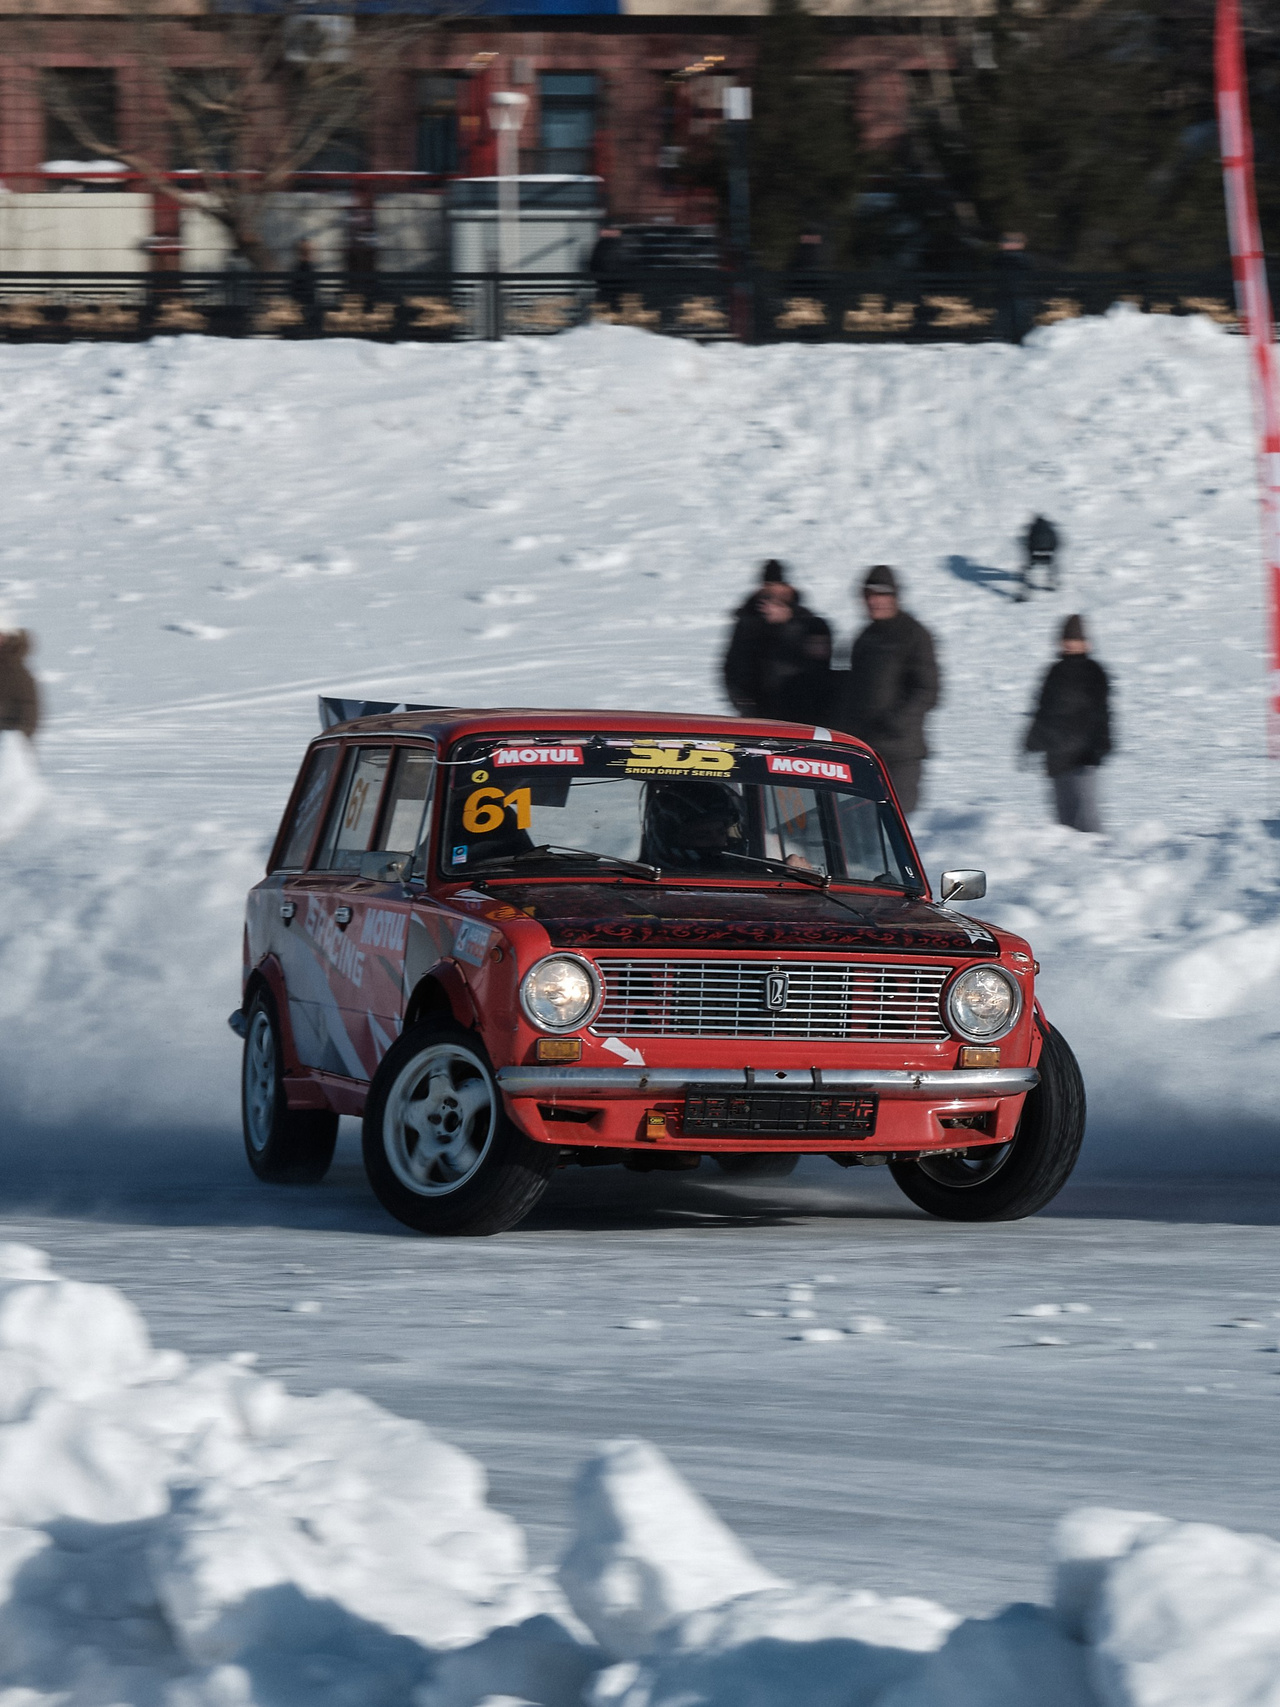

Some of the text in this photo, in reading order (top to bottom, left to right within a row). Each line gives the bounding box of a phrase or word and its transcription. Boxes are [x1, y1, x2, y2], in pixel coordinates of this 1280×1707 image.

[497, 747, 580, 766] MOTUL
[624, 767, 732, 778] SNOW DRIFT SERIES
[770, 758, 849, 780] MOTUL
[461, 786, 532, 834] 61
[360, 907, 407, 952] MOTUL
